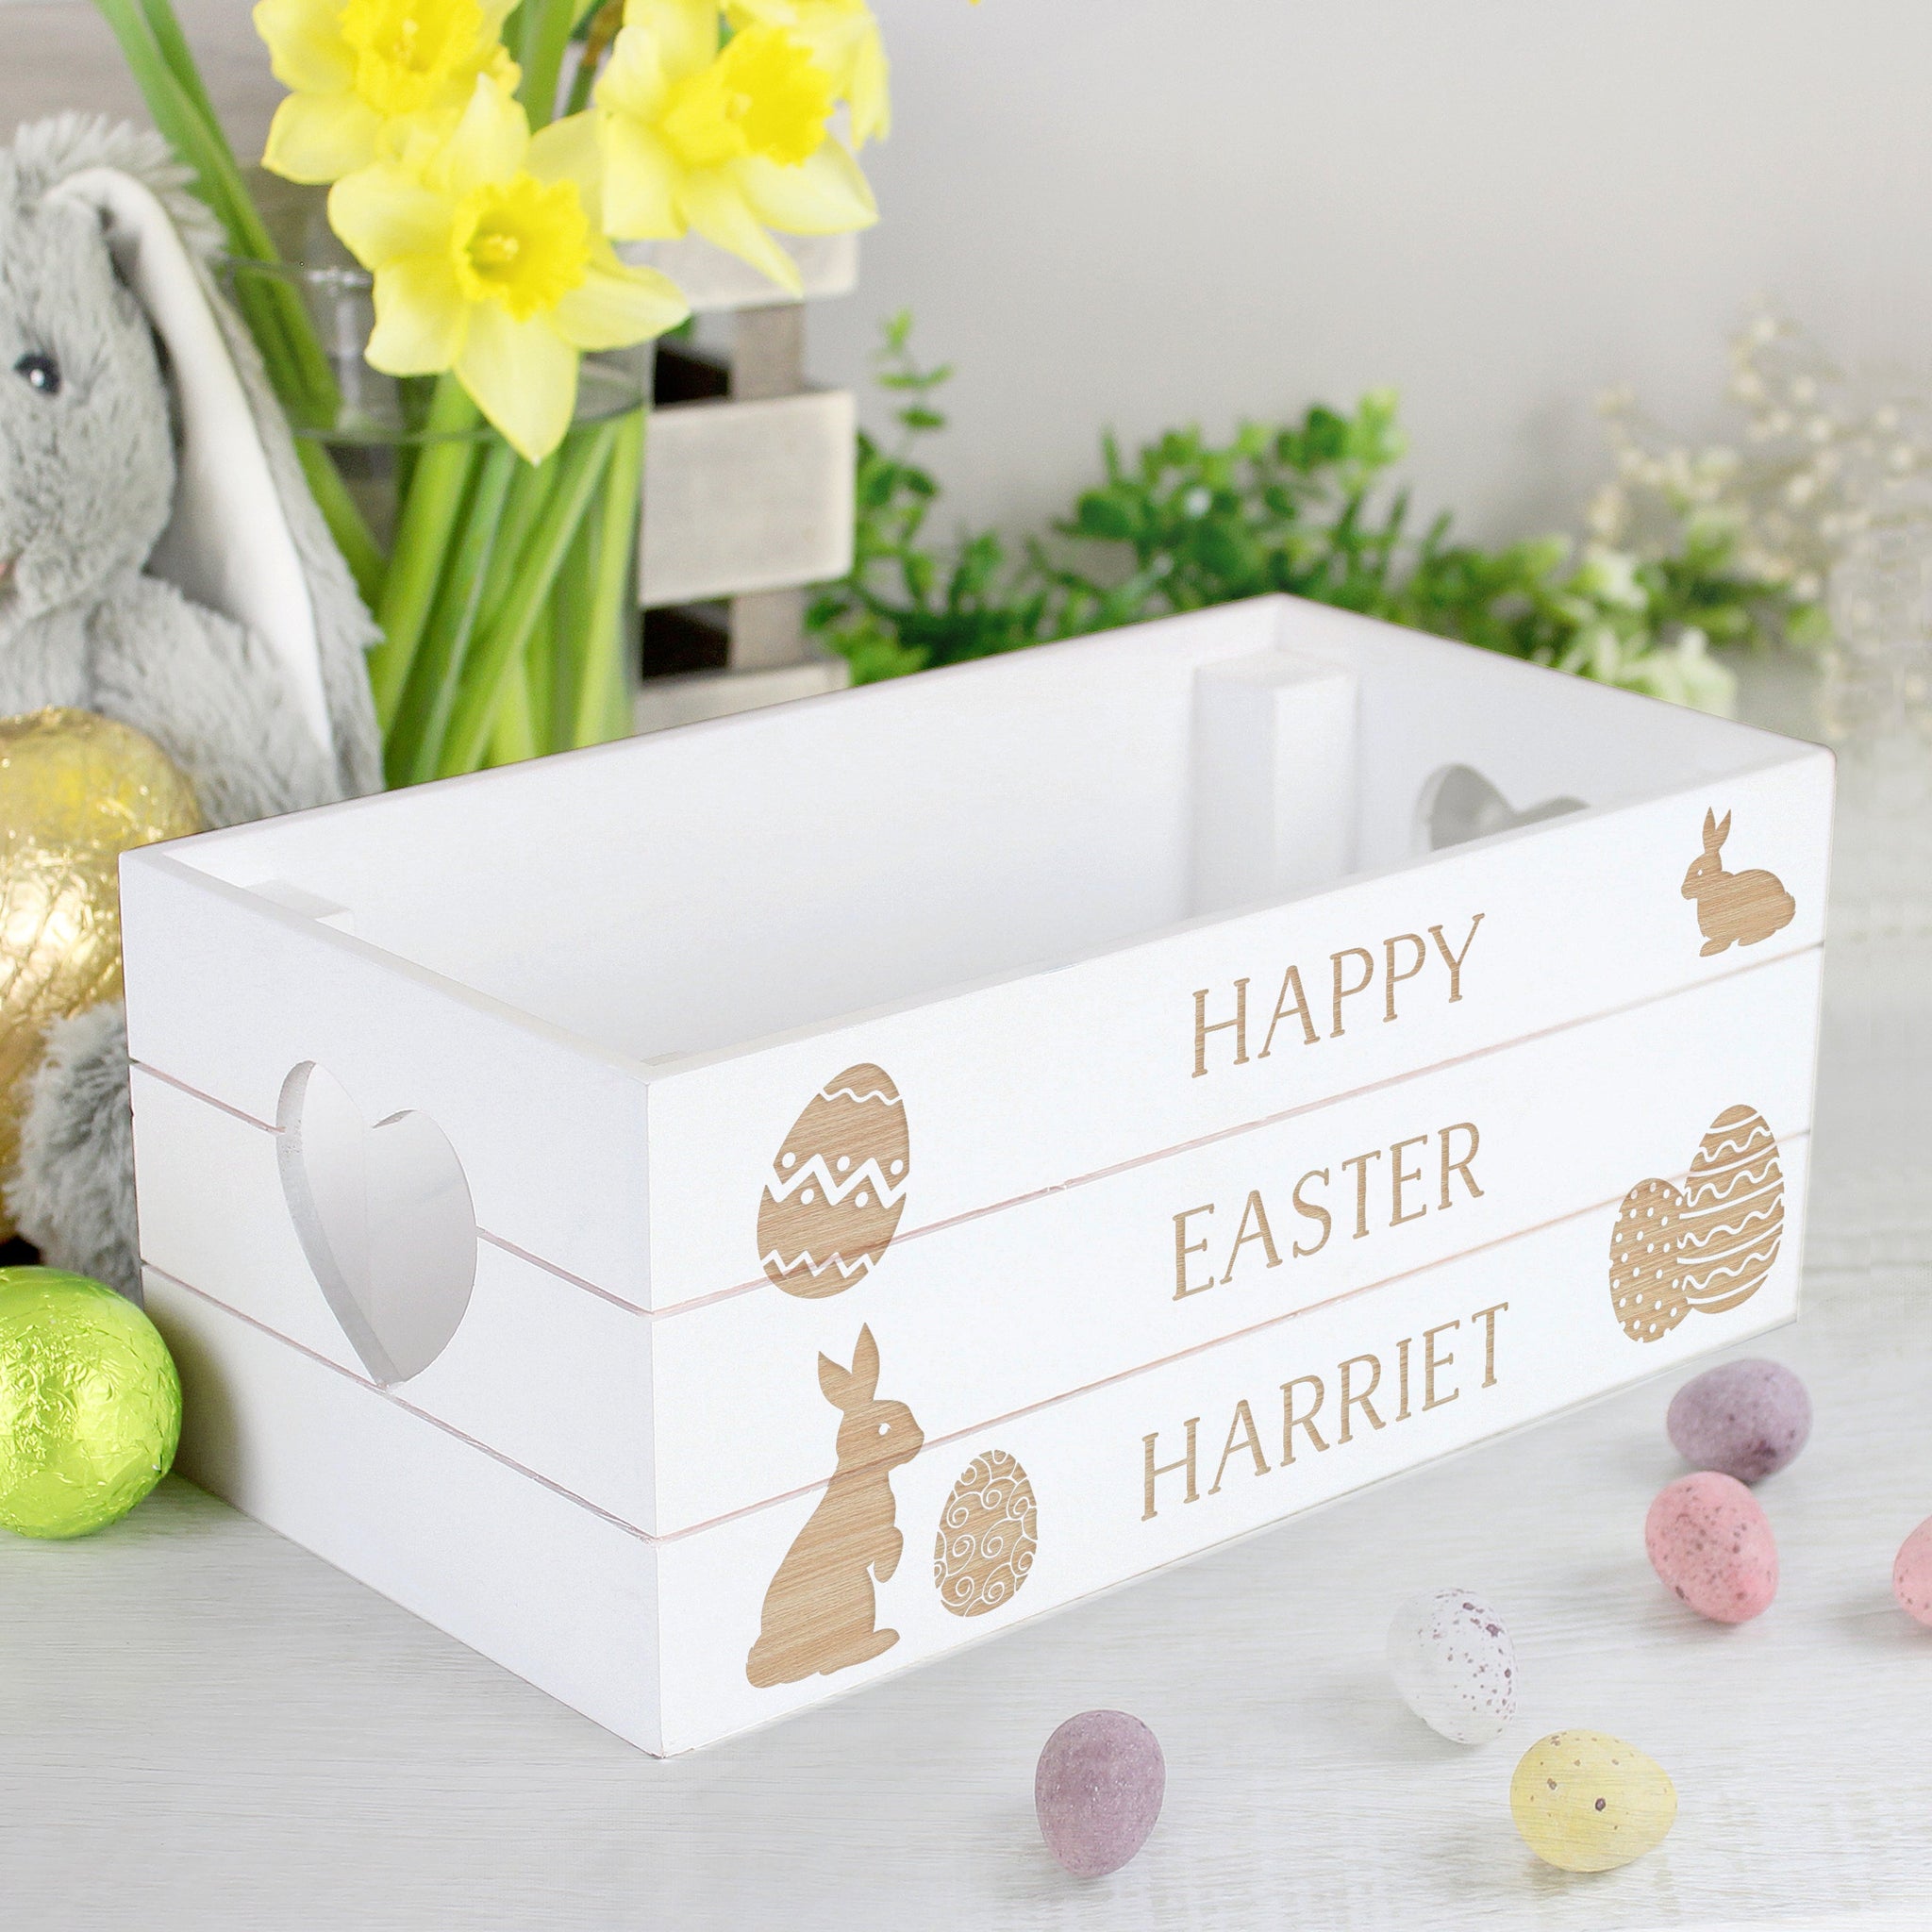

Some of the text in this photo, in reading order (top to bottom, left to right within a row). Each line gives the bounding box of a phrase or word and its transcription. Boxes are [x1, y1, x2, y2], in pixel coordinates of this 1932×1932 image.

[1191, 913, 1486, 1078] HAPPY
[1172, 1122, 1485, 1301] EASTER
[1141, 1302, 1509, 1521] HARRIET
